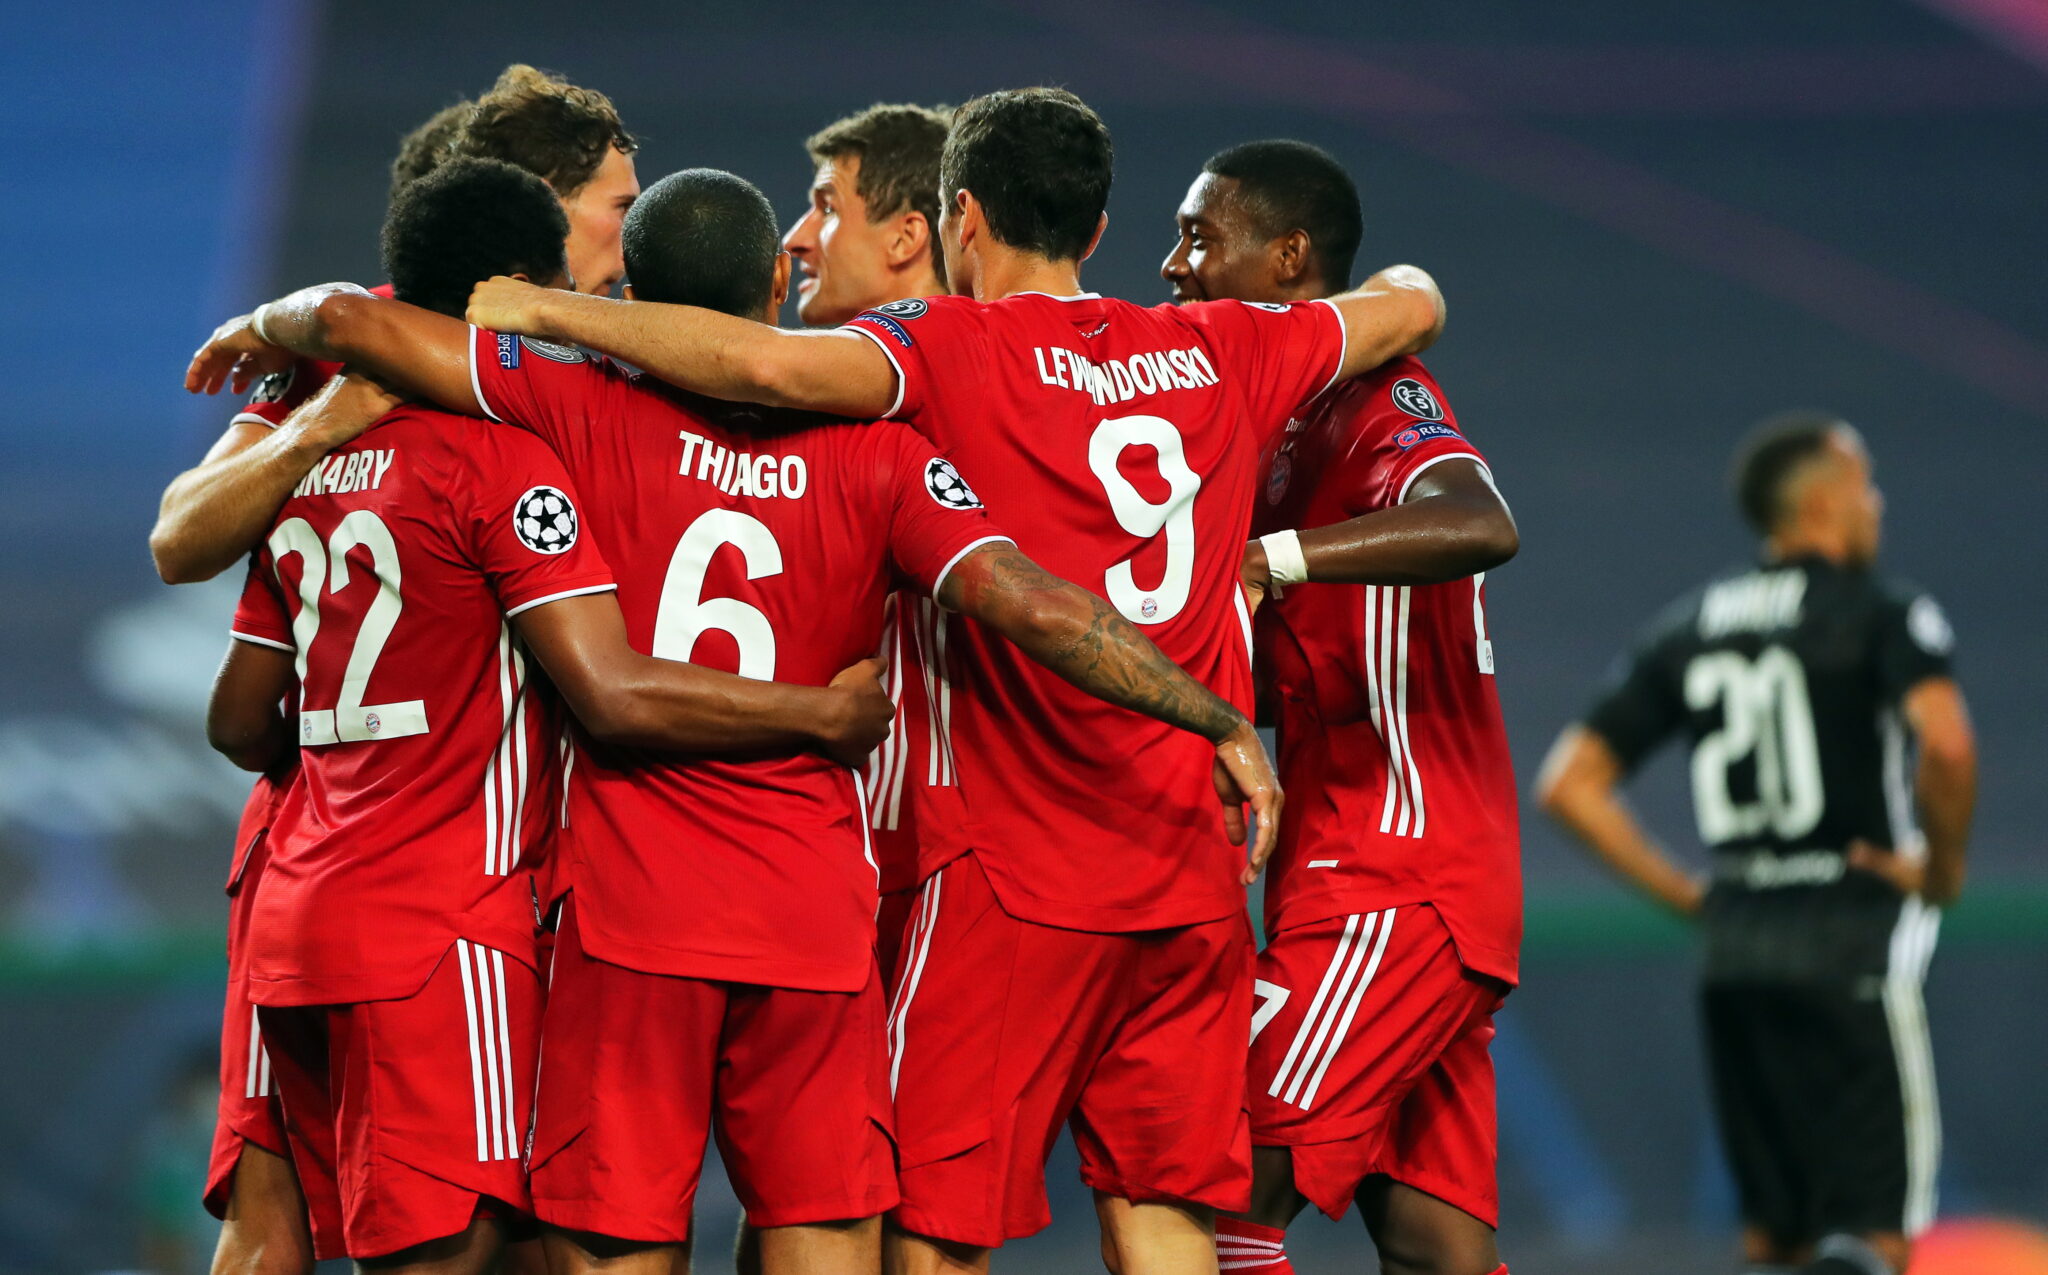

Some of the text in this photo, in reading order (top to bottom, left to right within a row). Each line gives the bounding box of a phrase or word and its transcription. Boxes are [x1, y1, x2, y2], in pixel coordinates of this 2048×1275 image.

[497, 334, 511, 368] ESPECT
[1033, 346, 1220, 406] LEWNDOWSKI
[1416, 398, 1429, 409] 5
[679, 430, 807, 499] THIAGO
[1088, 415, 1202, 625] 9
[268, 509, 429, 746] 22
[652, 507, 783, 682] 6
[1685, 646, 1824, 844] 20
